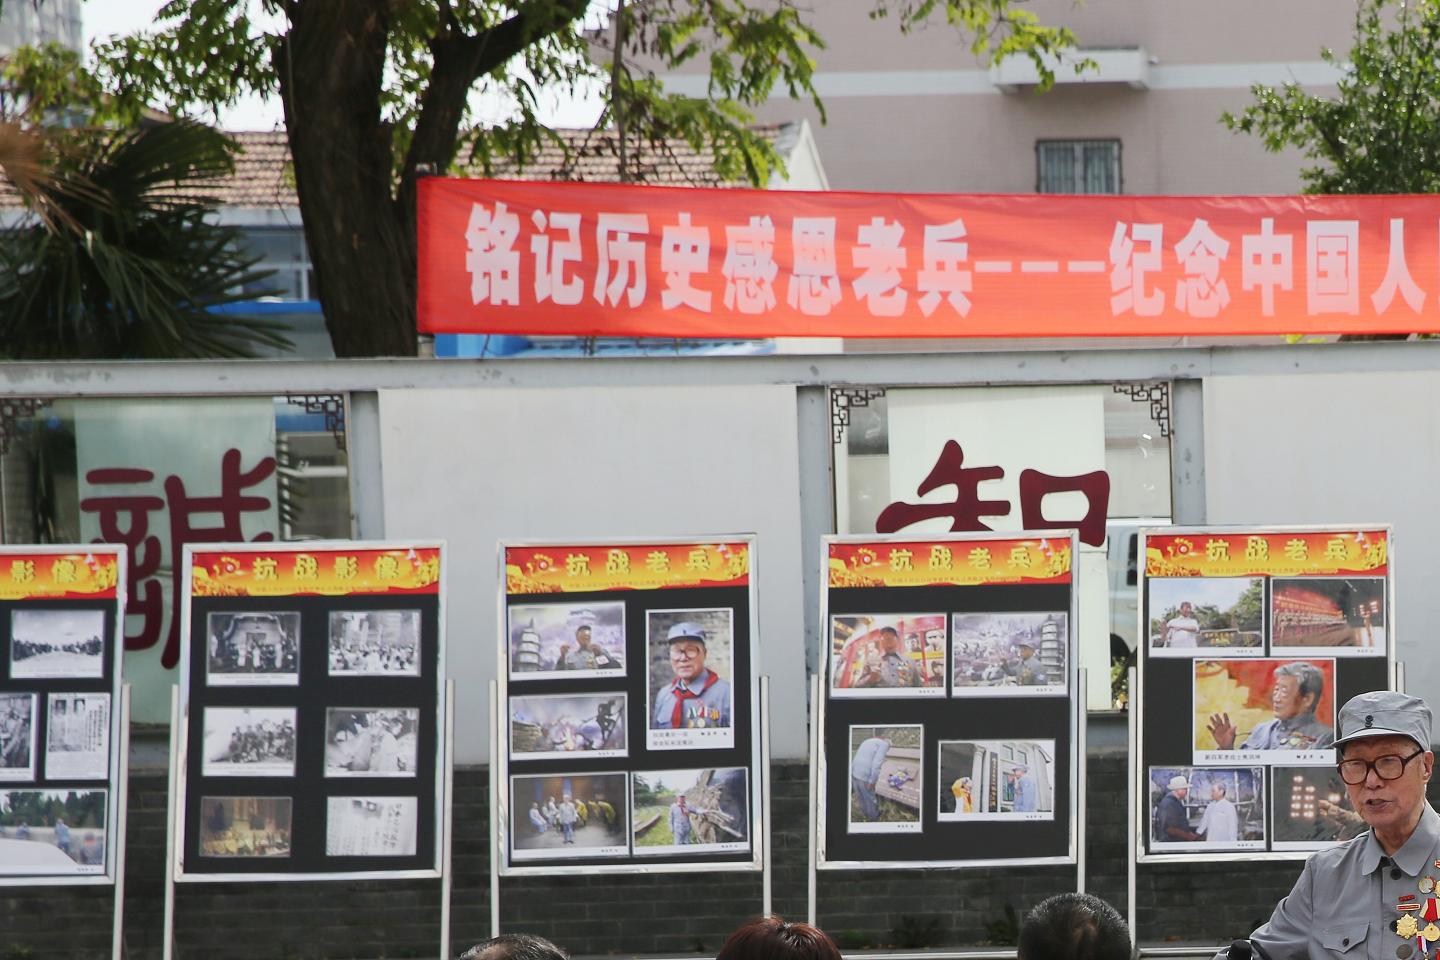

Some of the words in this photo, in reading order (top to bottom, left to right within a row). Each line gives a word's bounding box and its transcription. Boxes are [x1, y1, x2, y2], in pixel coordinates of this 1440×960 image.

[566, 548, 711, 576] 抗战老兵
[889, 546, 1032, 572] 抗战老兵
[1205, 537, 1348, 562] 抗战老兵
[252, 555, 402, 582] 抗战影像
